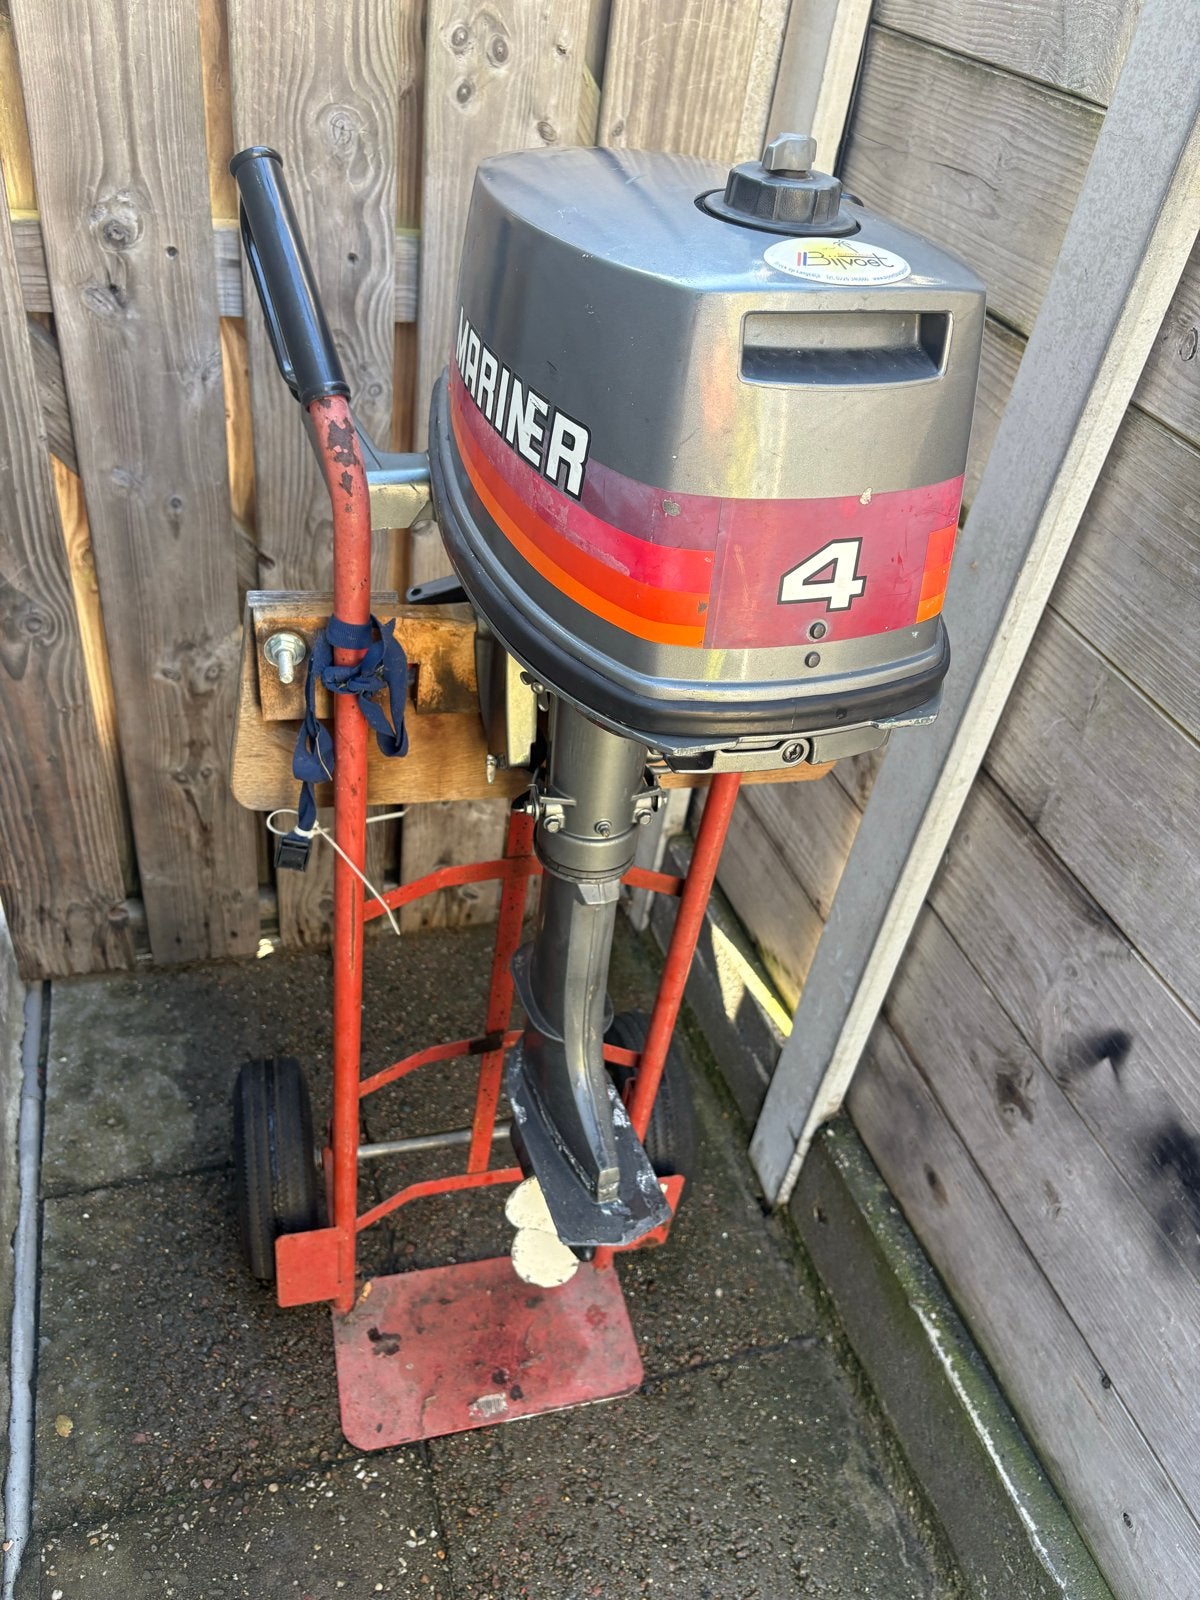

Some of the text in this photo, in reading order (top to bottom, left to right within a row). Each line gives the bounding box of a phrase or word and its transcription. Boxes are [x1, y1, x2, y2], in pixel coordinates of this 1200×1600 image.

[807, 251, 894, 270] Bijvoet
[455, 303, 592, 501] MARINER
[777, 537, 867, 612] 4
